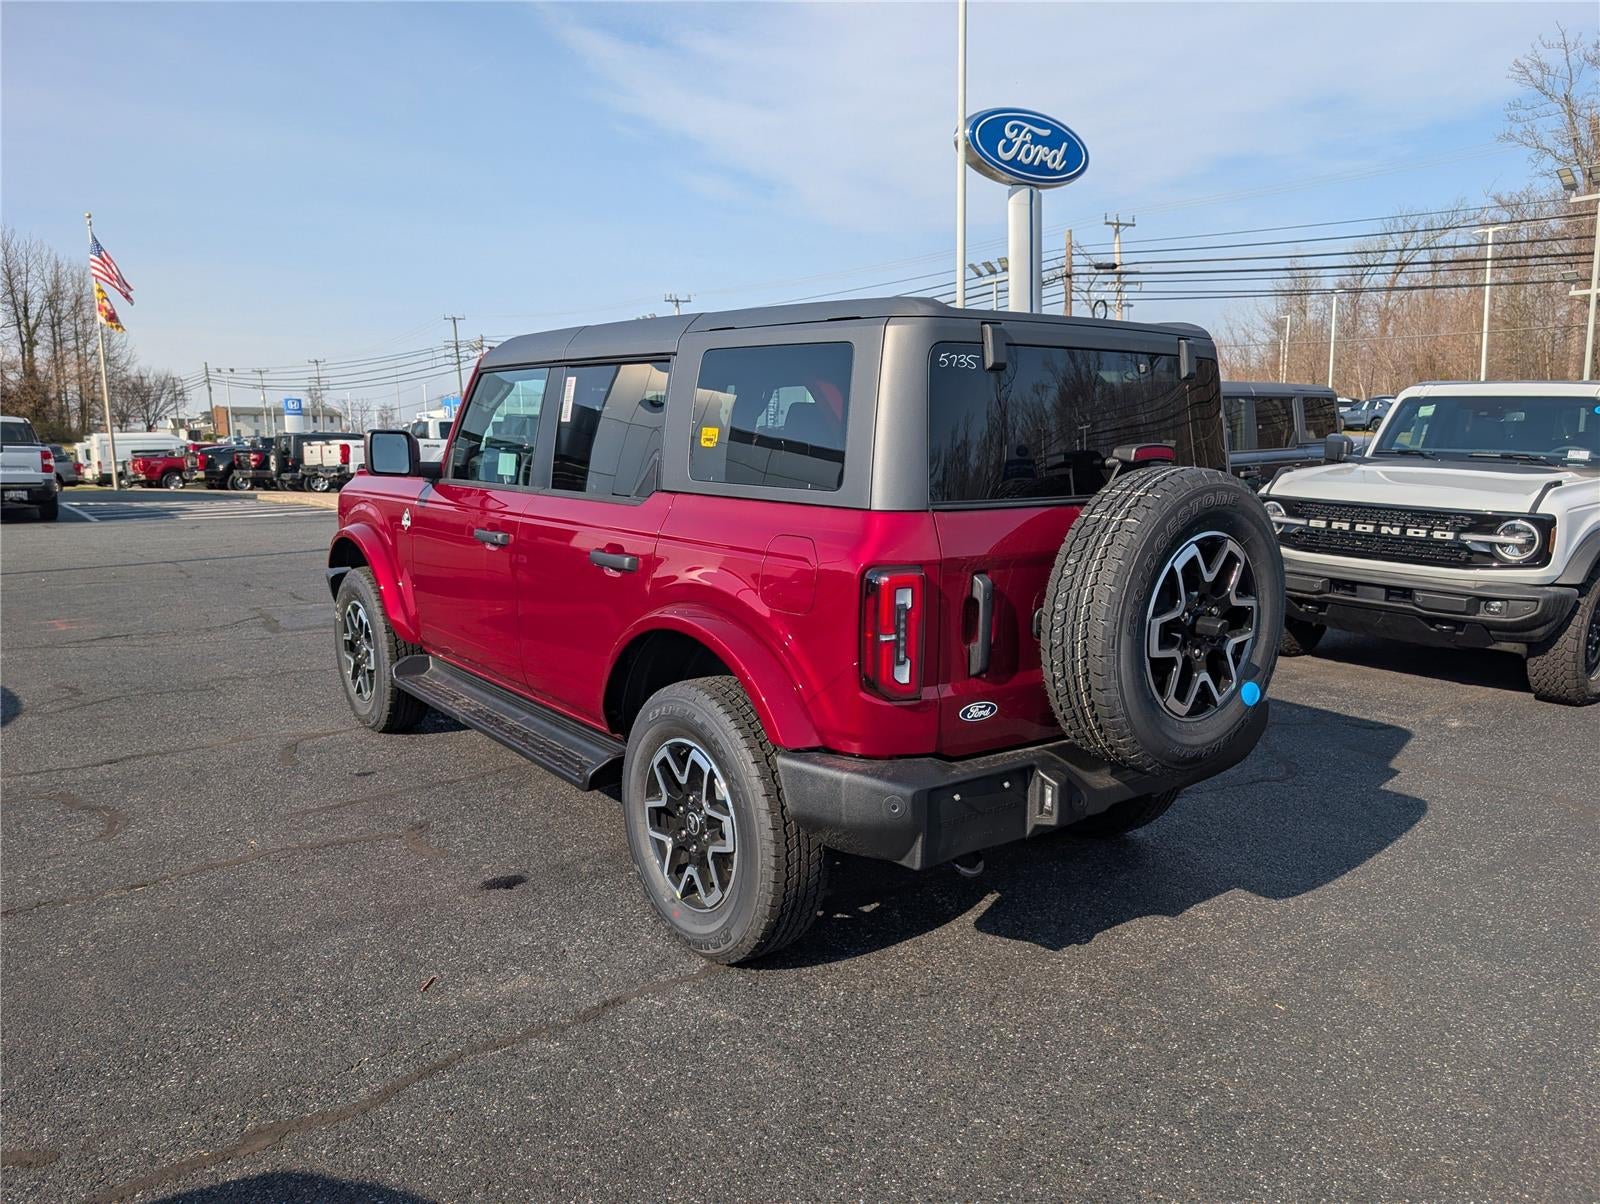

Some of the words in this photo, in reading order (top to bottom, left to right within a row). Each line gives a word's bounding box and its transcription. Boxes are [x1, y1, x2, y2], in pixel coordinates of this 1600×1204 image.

[997, 119, 1068, 171] Ford
[1308, 518, 1455, 540] BRONCO
[966, 704, 992, 719] Ford
